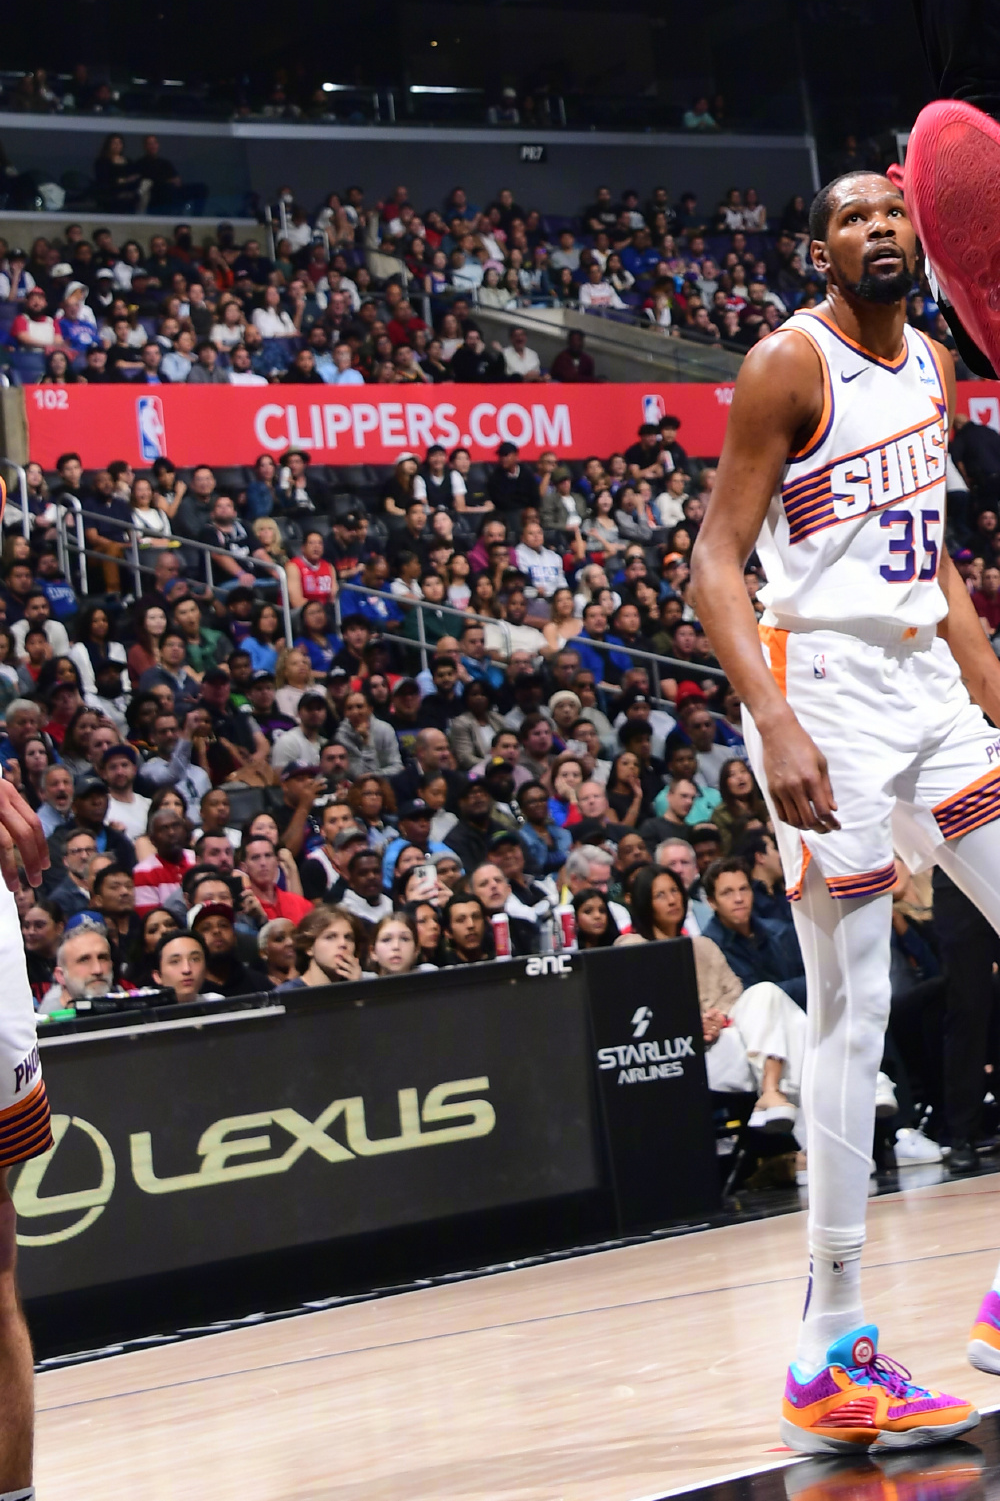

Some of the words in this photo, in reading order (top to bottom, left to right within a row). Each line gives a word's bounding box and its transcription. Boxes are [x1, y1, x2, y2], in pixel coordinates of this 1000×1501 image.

[34, 389, 70, 410] 102
[254, 402, 573, 451] CLIPPERS.COM
[831, 429, 947, 521] SUNS
[880, 510, 941, 583] 35
[526, 955, 573, 976] anc
[598, 1036, 696, 1069] STARLUX
[618, 1062, 685, 1085] AIRLINES
[130, 1075, 495, 1194] LEXUS
